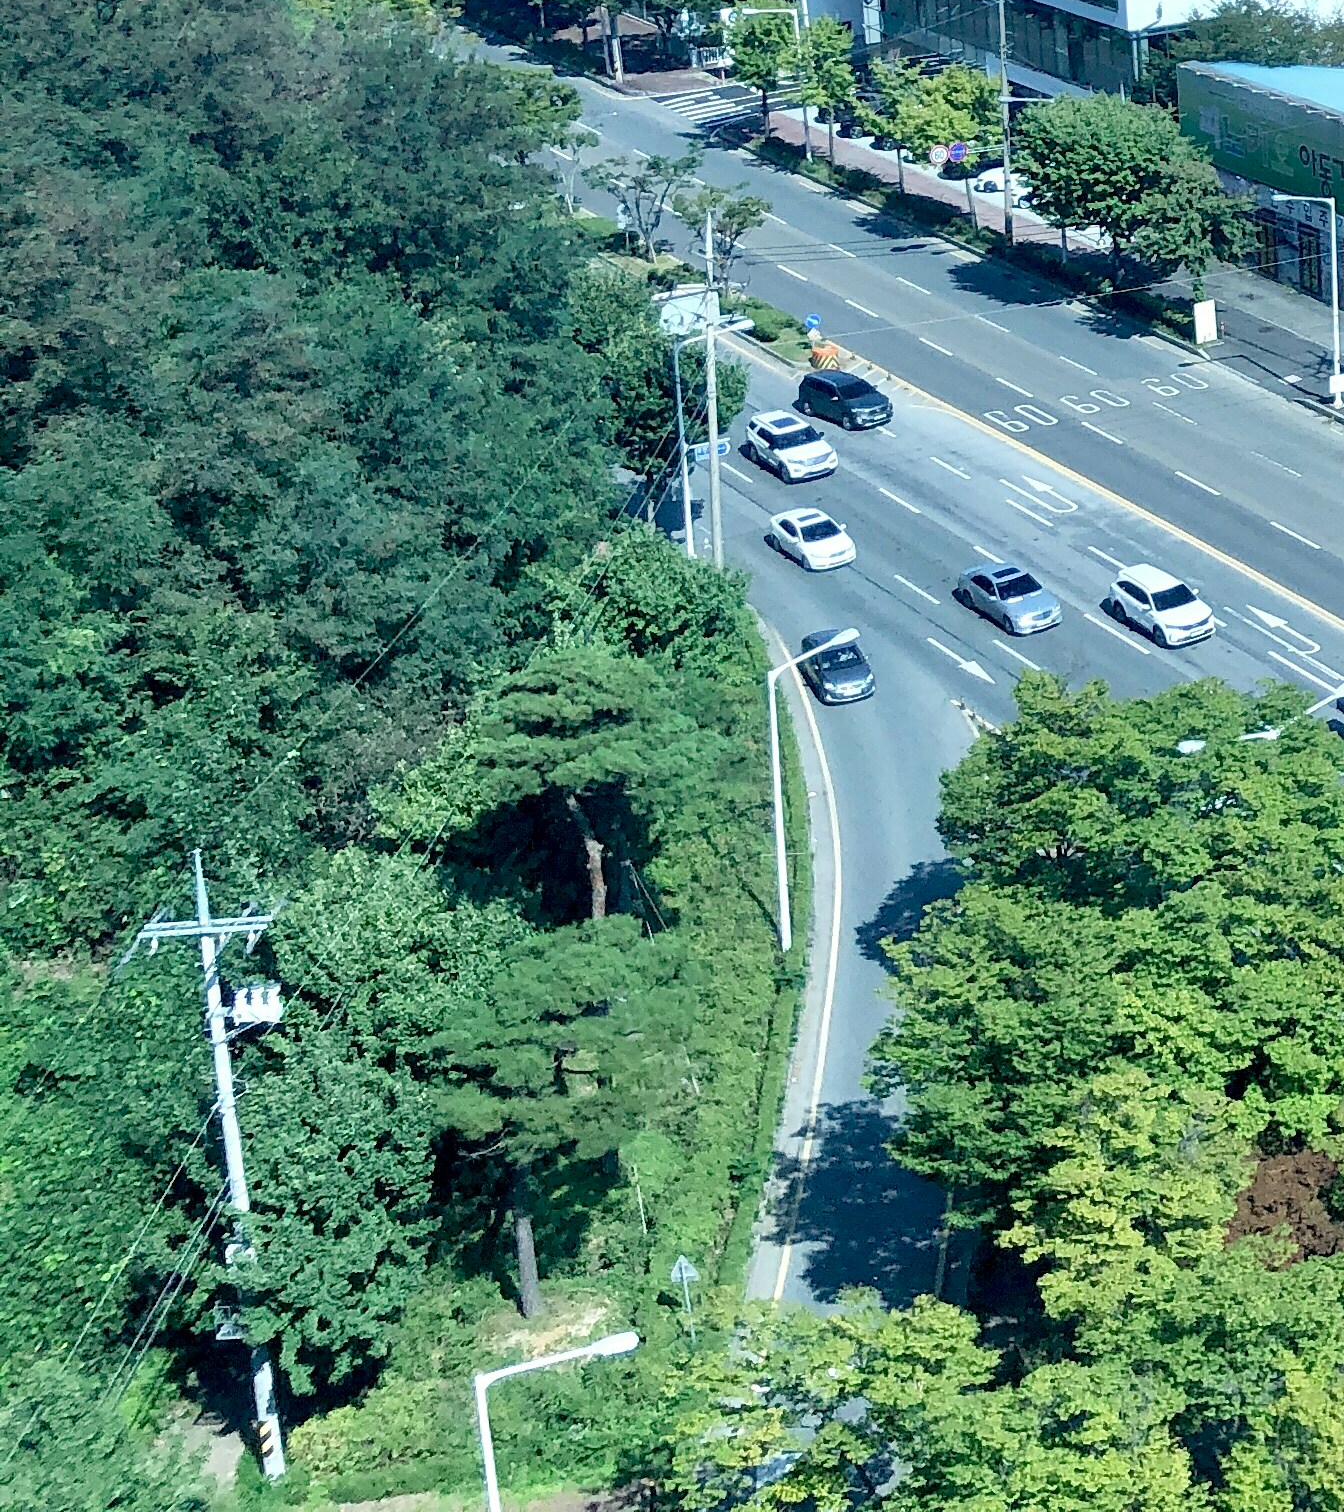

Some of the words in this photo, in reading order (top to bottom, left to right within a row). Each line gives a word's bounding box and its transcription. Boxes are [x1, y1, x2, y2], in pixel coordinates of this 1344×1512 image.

[1141, 372, 1209, 396] 60
[1060, 389, 1130, 414] 60
[983, 404, 1059, 433] 60
